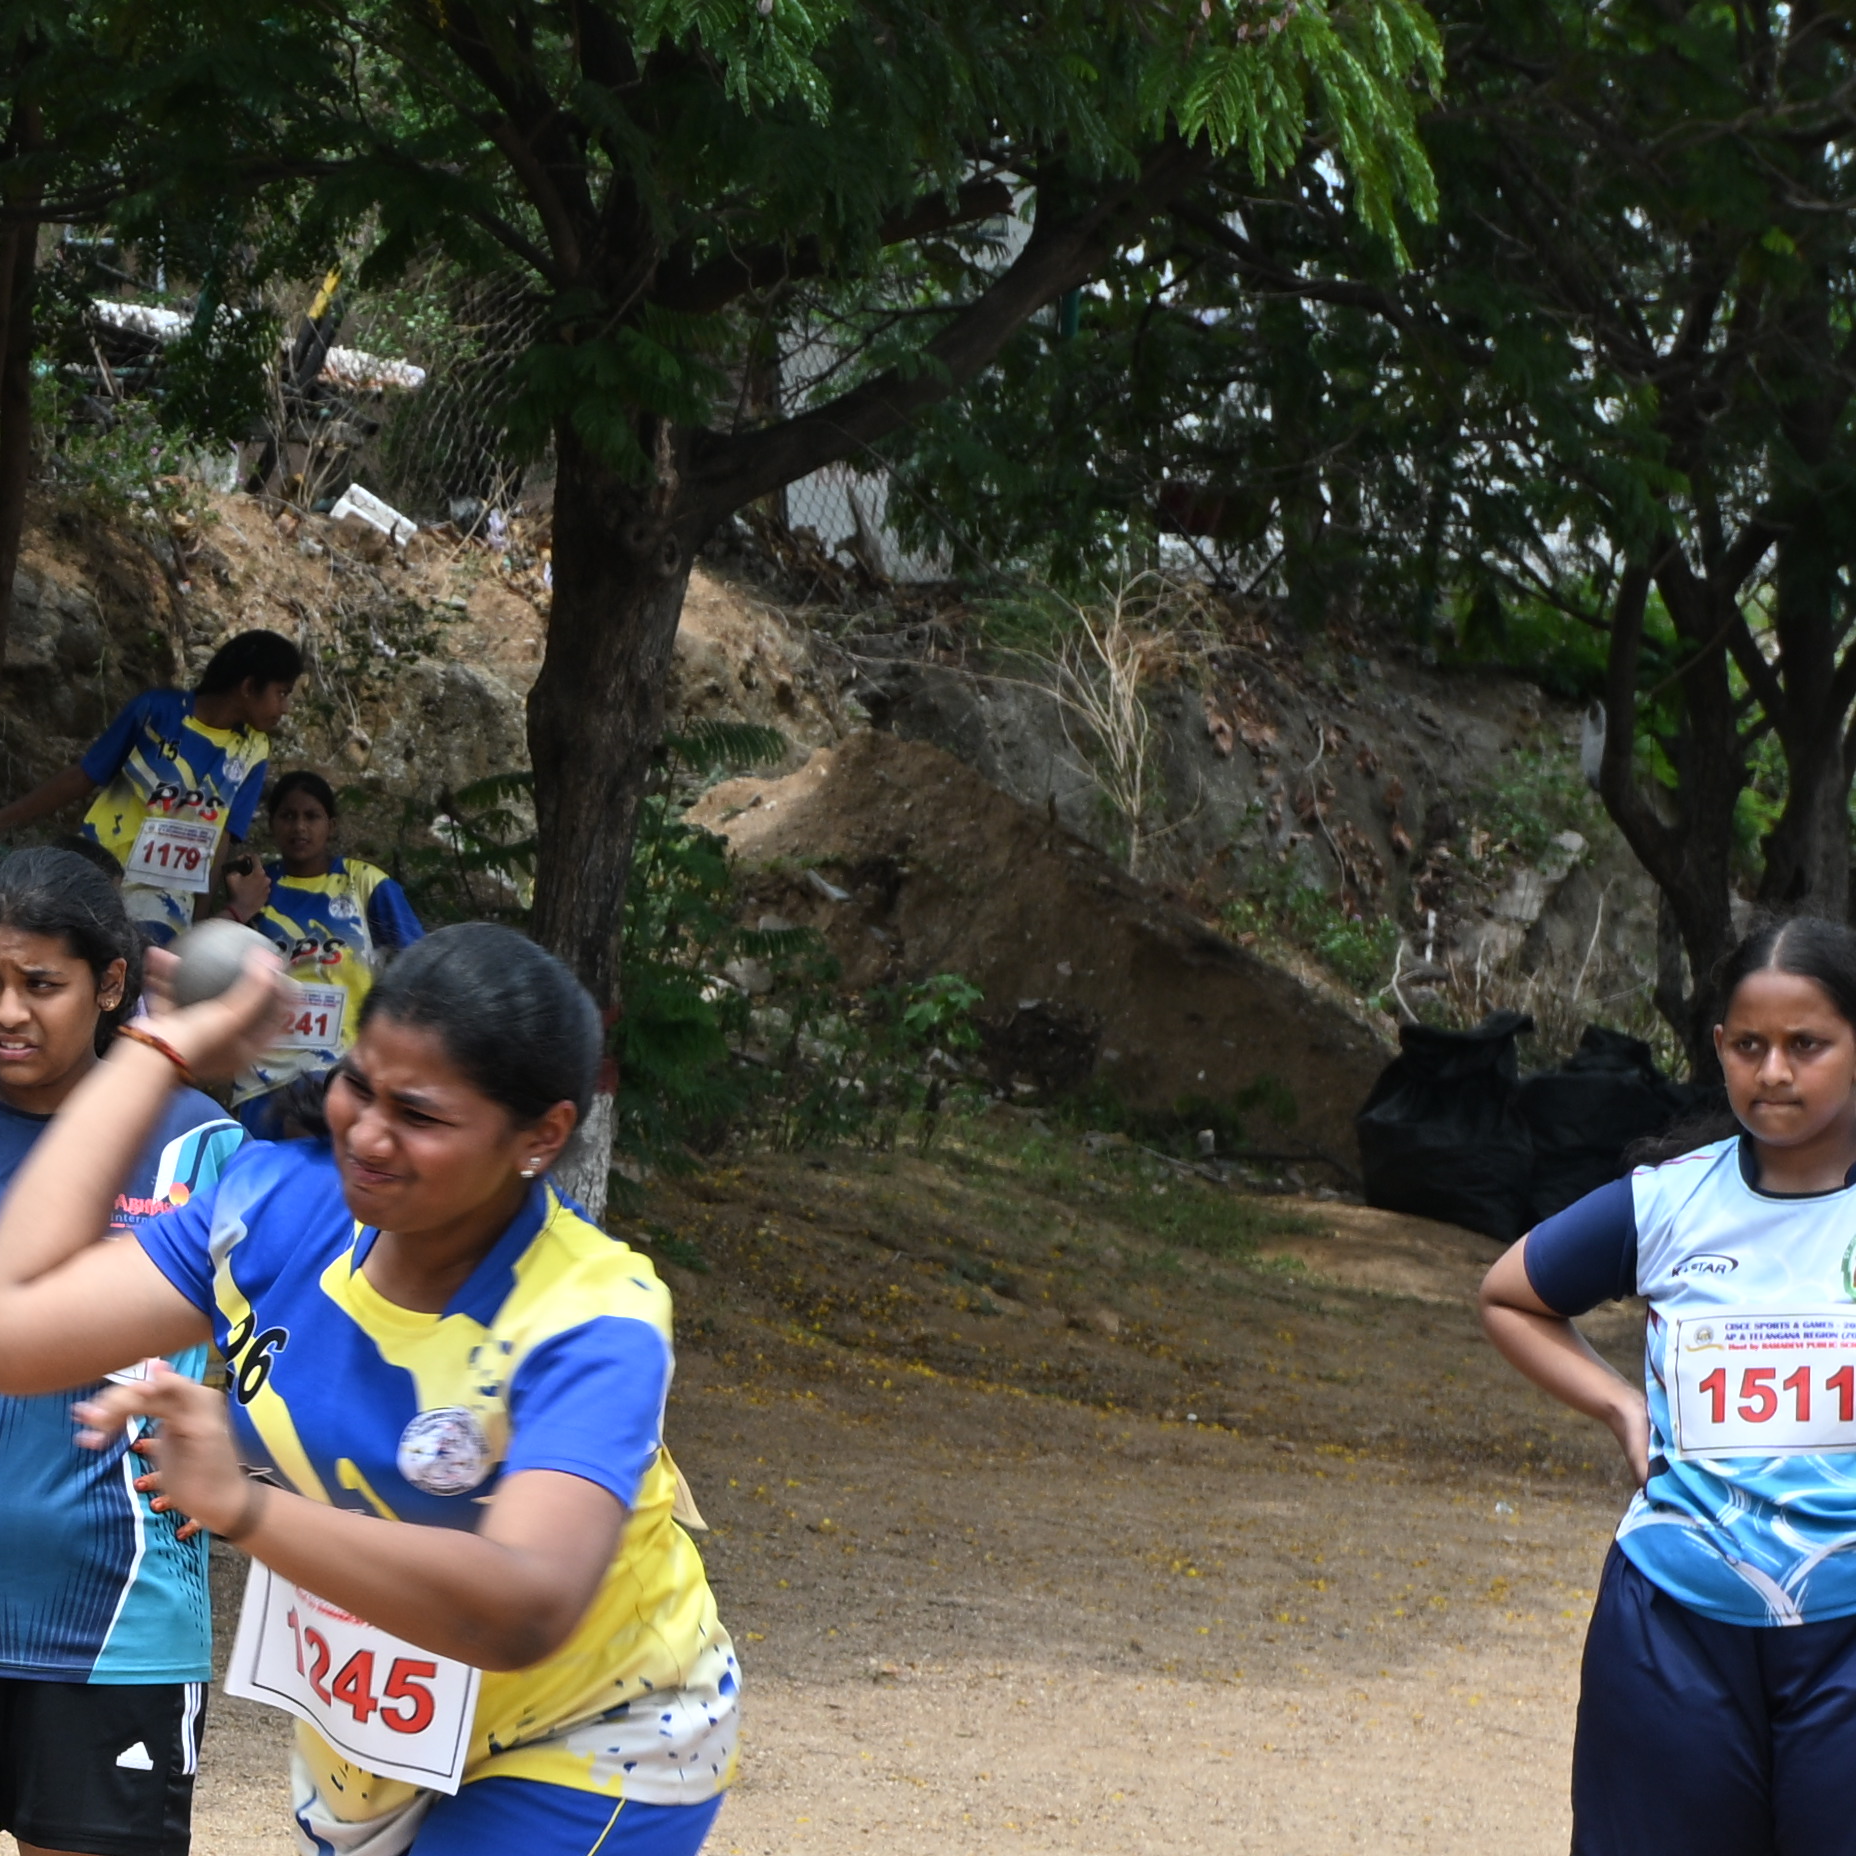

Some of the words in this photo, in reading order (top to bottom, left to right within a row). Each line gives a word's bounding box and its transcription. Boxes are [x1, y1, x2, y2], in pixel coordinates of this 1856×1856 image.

[157, 739, 181, 762] 15
[143, 839, 202, 871] 1179
[275, 937, 346, 966] PS
[281, 1011, 328, 1037] 241
[1699, 1365, 1854, 1424] 1511
[286, 1604, 438, 1735] 1245
